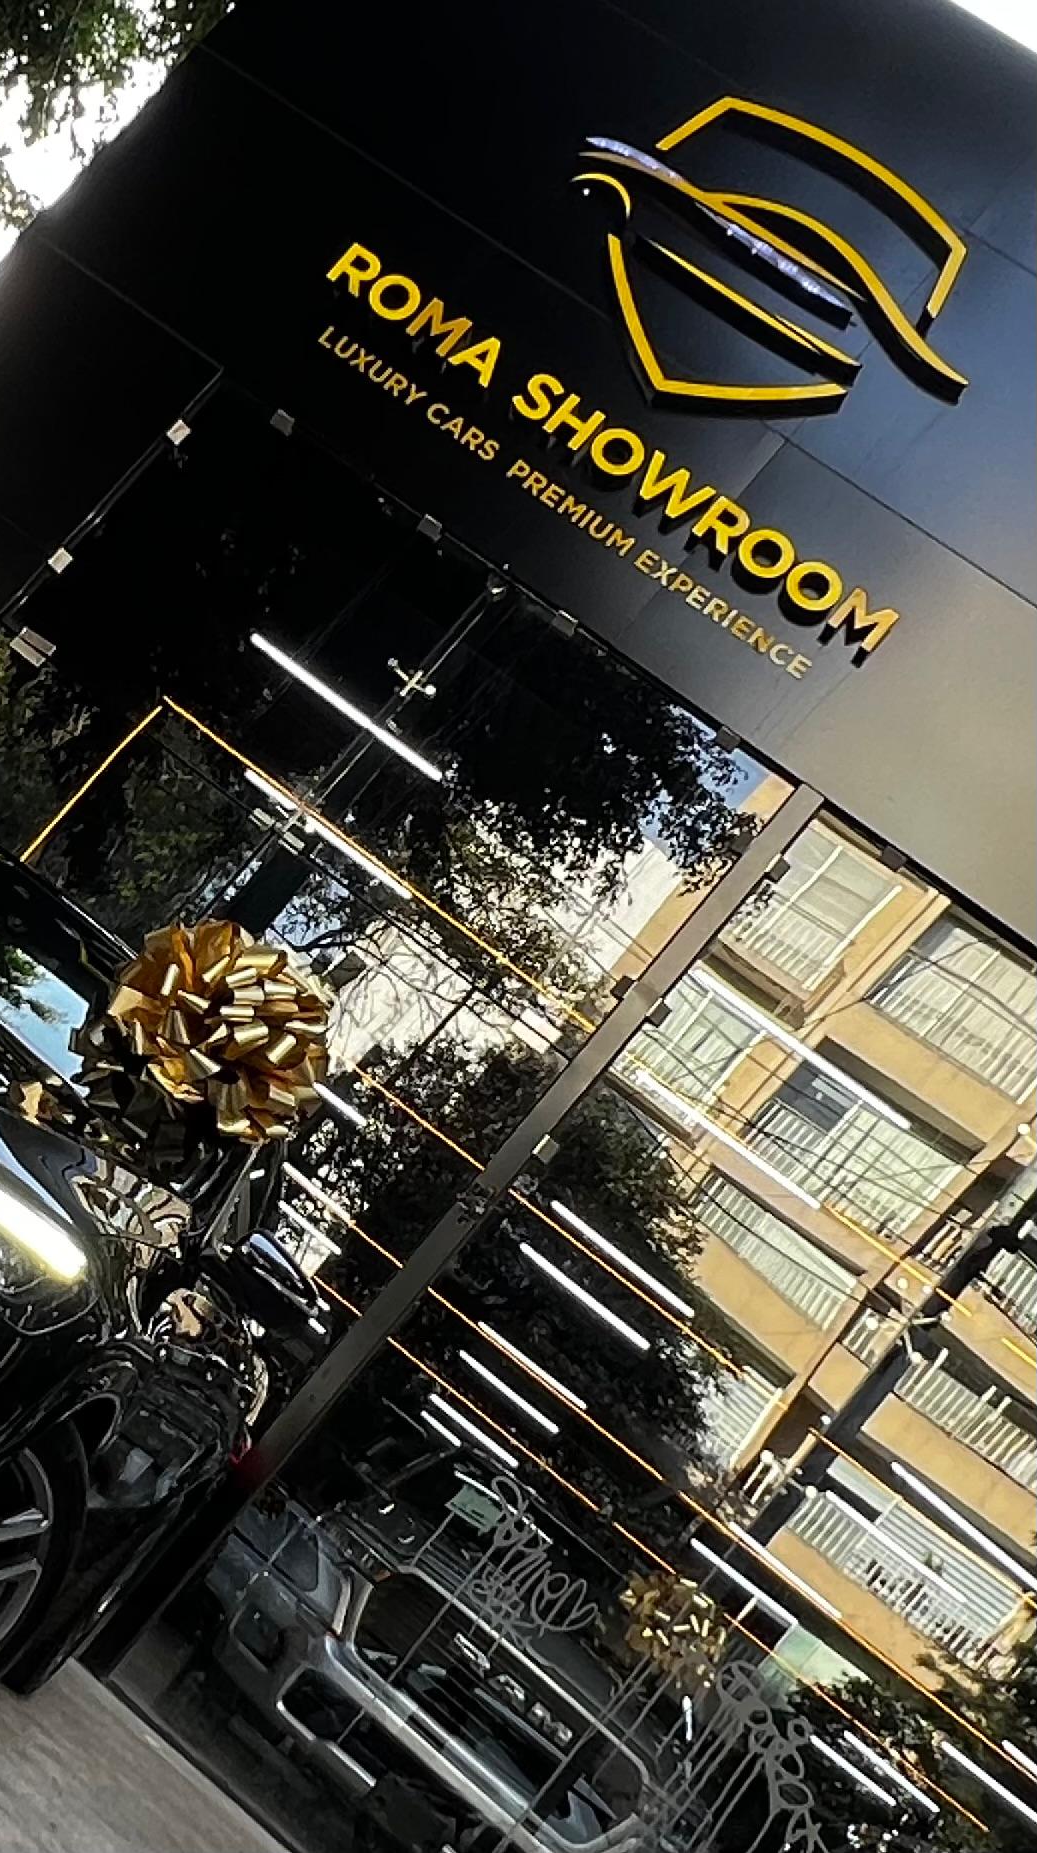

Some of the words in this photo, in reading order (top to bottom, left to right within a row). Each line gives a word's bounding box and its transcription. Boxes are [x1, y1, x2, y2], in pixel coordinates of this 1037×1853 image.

[318, 325, 429, 406] LUXURY
[426, 402, 501, 461] CARS
[505, 458, 637, 558] PREMIUM
[633, 549, 814, 680] EXPERIENCE
[325, 243, 504, 388] ROMA
[512, 373, 901, 655] SHOWROOM
